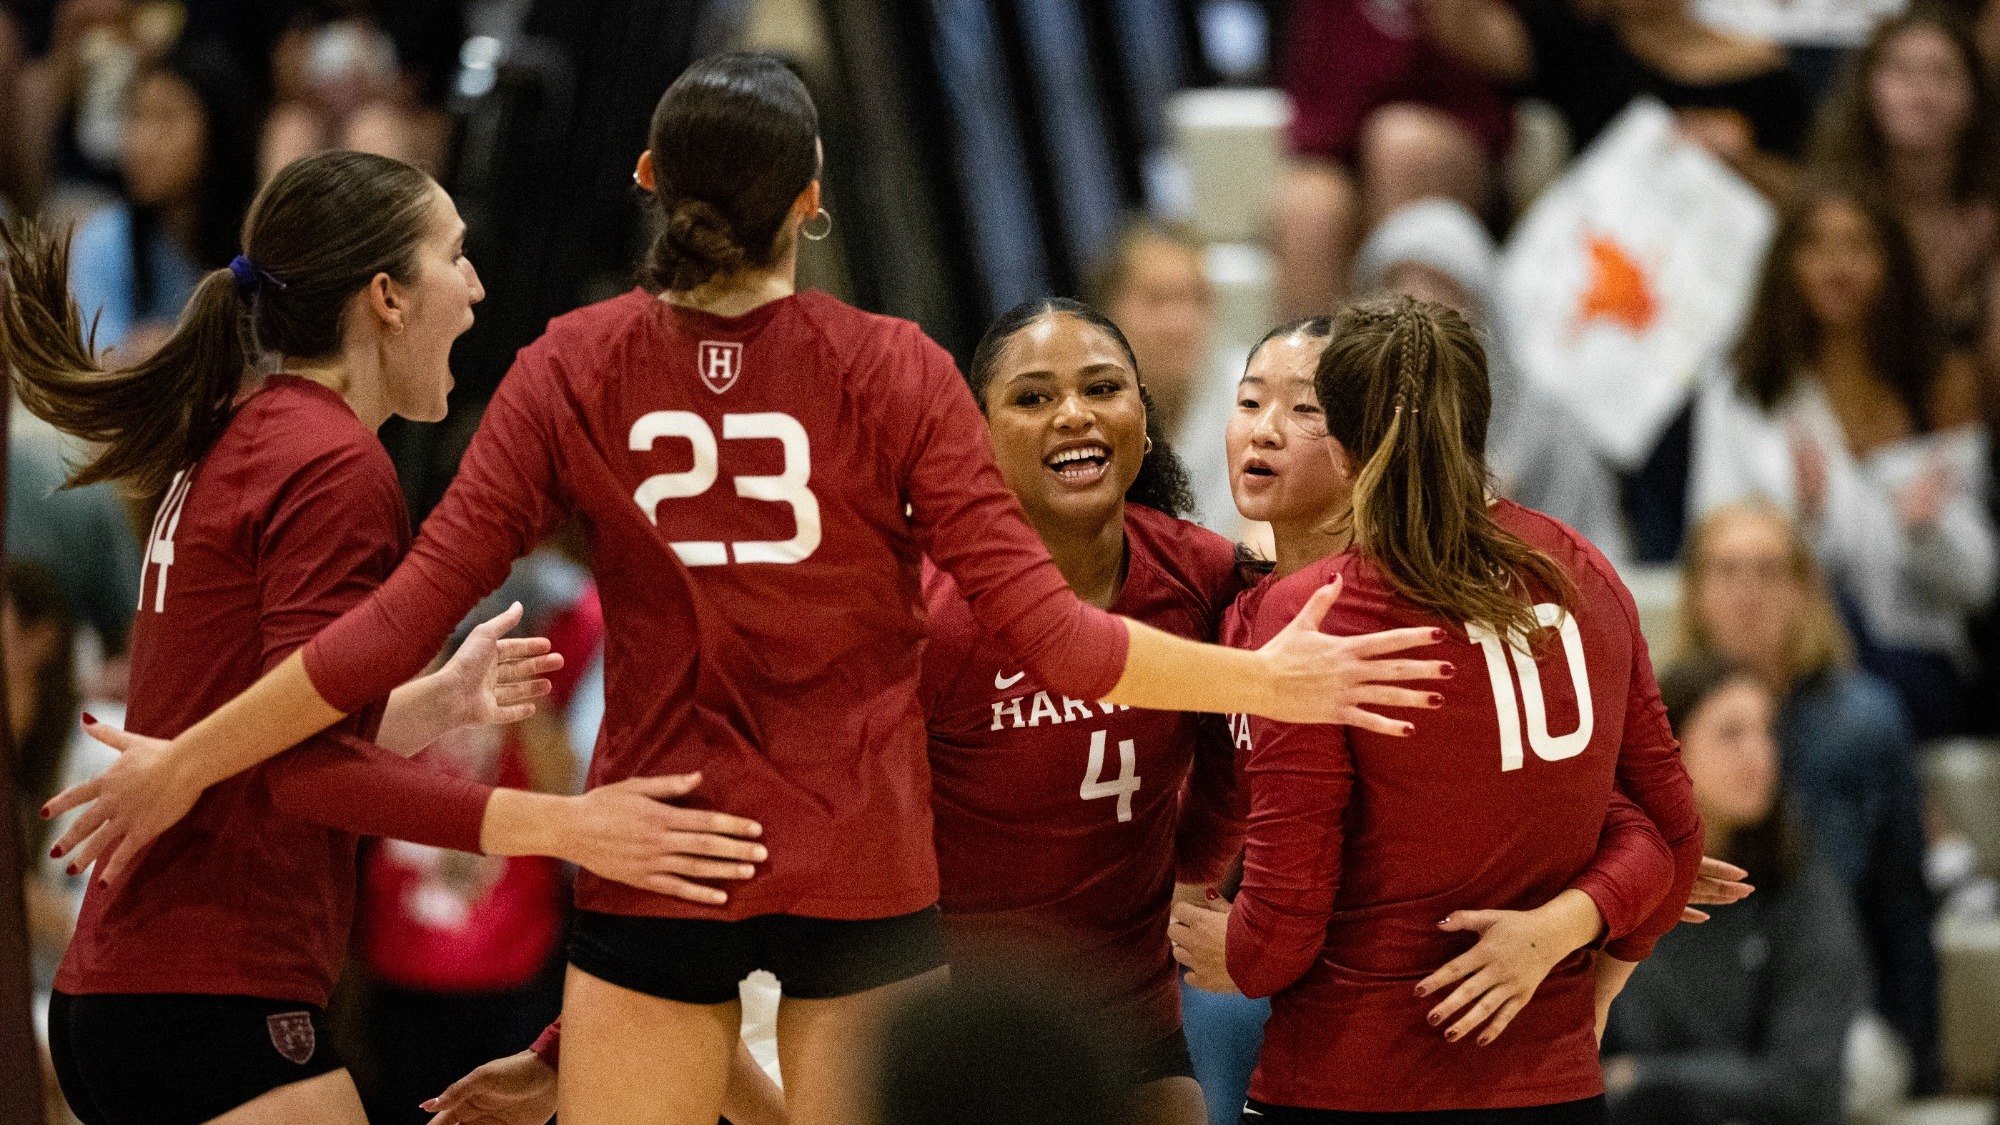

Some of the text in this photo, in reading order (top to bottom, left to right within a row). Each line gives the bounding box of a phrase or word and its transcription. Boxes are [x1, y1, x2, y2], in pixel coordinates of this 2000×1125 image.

[708, 347, 732, 379] H
[137, 462, 196, 613] 14
[629, 410, 822, 567] 23
[1464, 603, 1594, 772] 10
[1080, 729, 1141, 823] 4
